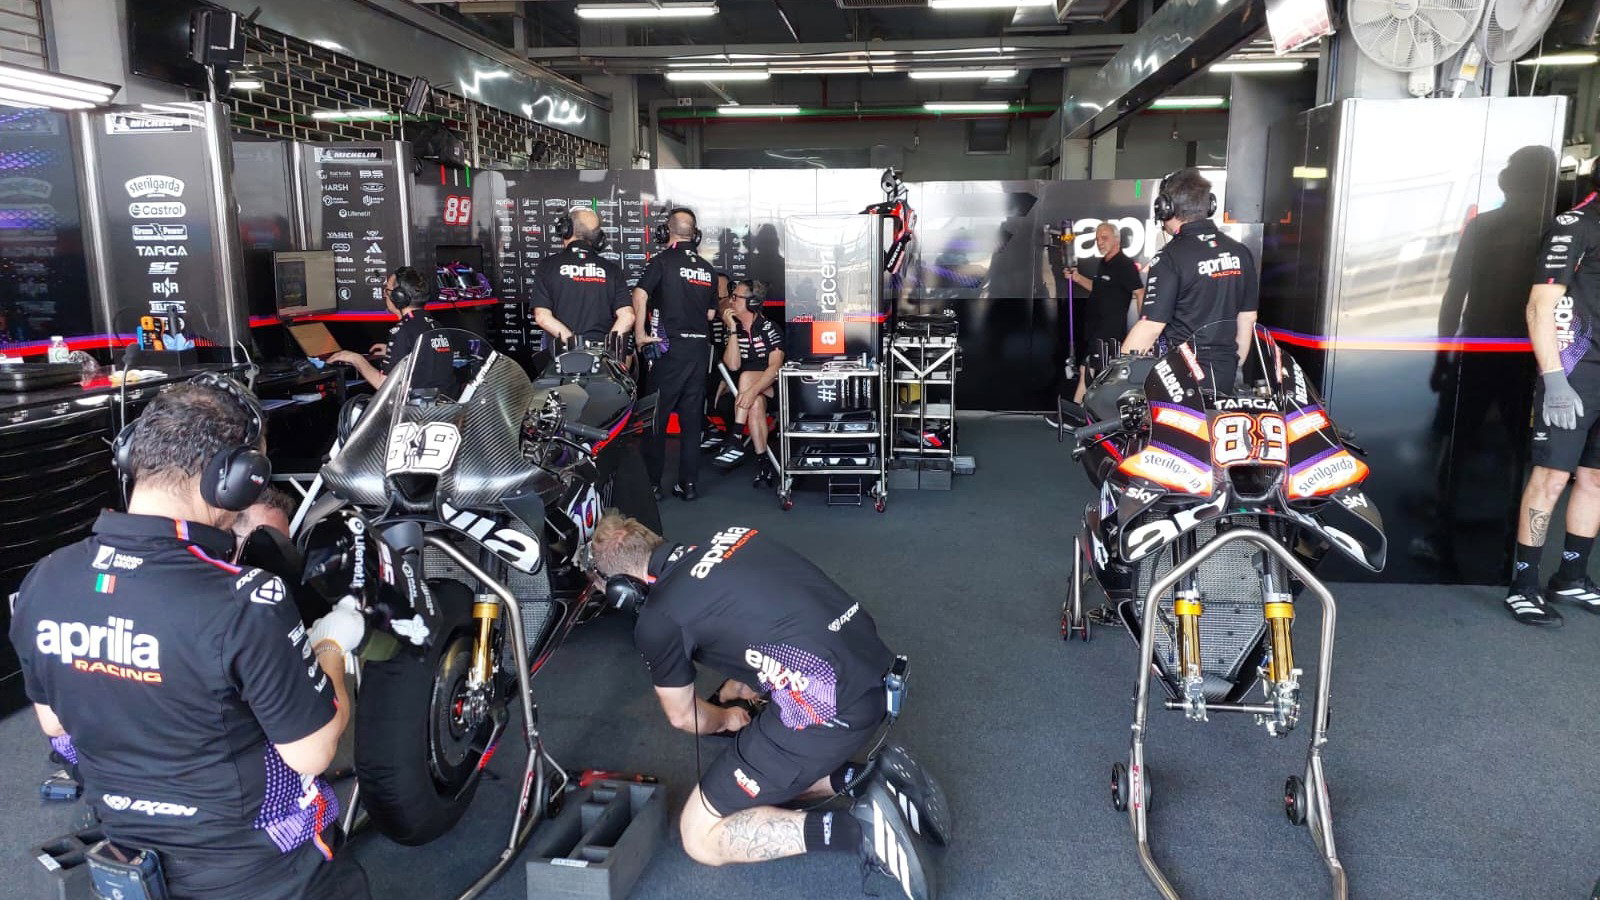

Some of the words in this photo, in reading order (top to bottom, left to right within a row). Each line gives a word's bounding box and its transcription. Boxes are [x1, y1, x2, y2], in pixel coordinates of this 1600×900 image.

[129, 177, 181, 194] sterilgarda
[142, 204, 183, 216] Castrol
[443, 195, 474, 225] 89
[135, 245, 188, 257] TARGA
[559, 262, 607, 279] aprilia
[679, 266, 712, 283] aprilia
[1198, 251, 1241, 276] aprilia
[1213, 398, 1279, 412] TARGA
[385, 421, 462, 477] 89
[1212, 412, 1289, 467] 89
[1298, 457, 1355, 493] sterilgarda
[1125, 486, 1159, 504] sky
[1341, 491, 1368, 510] sky
[690, 526, 752, 579] aprilia
[36, 615, 161, 670] aprilia
[74, 659, 163, 684] RACING
